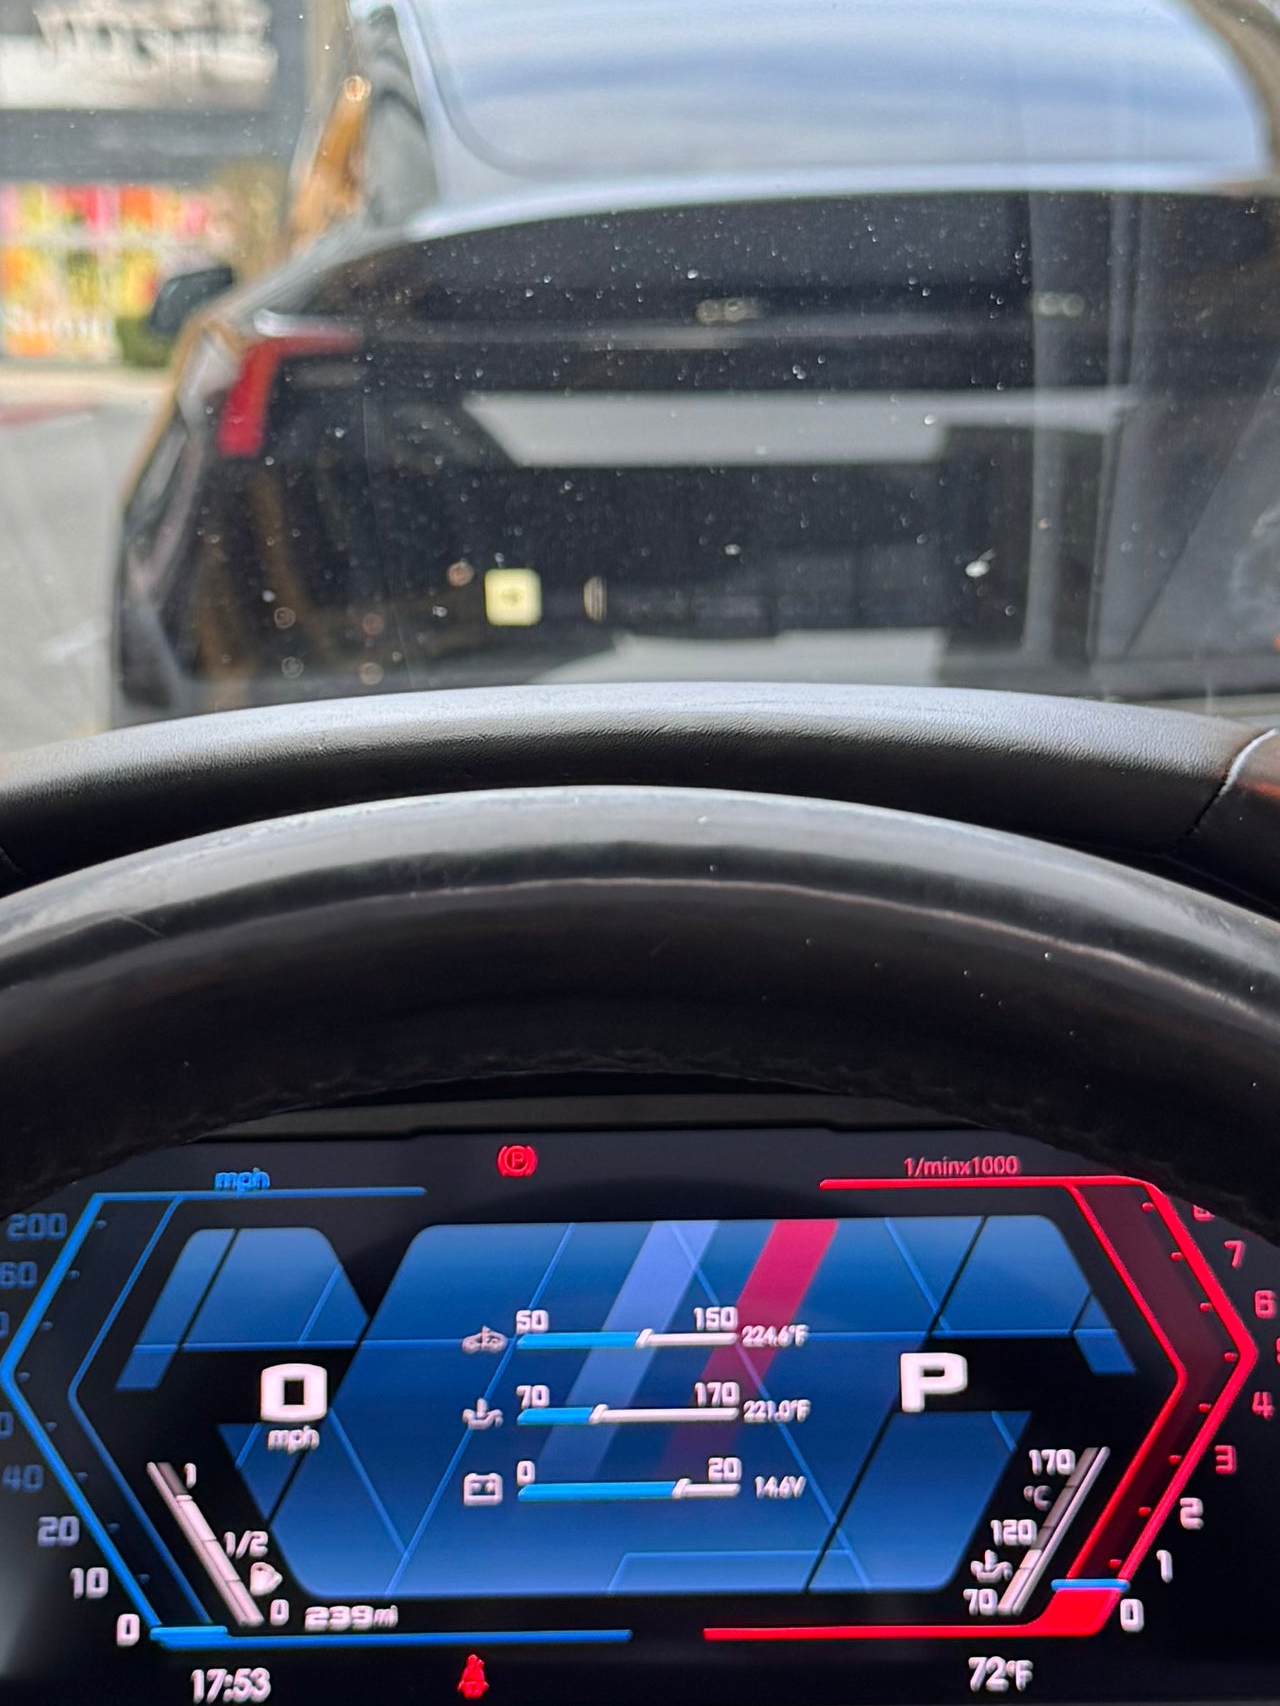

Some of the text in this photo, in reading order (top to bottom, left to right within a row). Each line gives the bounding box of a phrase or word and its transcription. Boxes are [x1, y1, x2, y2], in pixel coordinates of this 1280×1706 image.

[214, 1167, 271, 1192] mph
[6, 1213, 67, 1240] 200
[1223, 1239, 1245, 1269] 7
[693, 1306, 739, 1331] 150
[1254, 1289, 1277, 1319] 6
[515, 1309, 549, 1334] 50
[260, 1362, 328, 1423] 0
[516, 1384, 550, 1409] 70
[694, 1381, 741, 1407] 170
[900, 1351, 968, 1414] P
[1251, 1391, 1275, 1421] 4
[267, 1425, 321, 1454] mph
[516, 1460, 536, 1486] 0
[707, 1456, 743, 1483] 20
[1028, 1448, 1076, 1476] 170
[1214, 1444, 1237, 1475] 3
[1, 1464, 44, 1492] 40
[184, 1462, 198, 1489] 1
[1179, 1497, 1205, 1530] 2
[37, 1515, 80, 1547] 20
[223, 1529, 269, 1559] 1/2
[990, 1518, 1038, 1546] 120
[1156, 1549, 1174, 1583] 1
[70, 1566, 110, 1600] 10
[269, 1598, 290, 1626] 0
[963, 1588, 999, 1616] 70
[1120, 1598, 1146, 1633] 0
[116, 1612, 141, 1647] 0
[190, 1666, 272, 1704] 17:53
[968, 1655, 1035, 1693] 72°F
